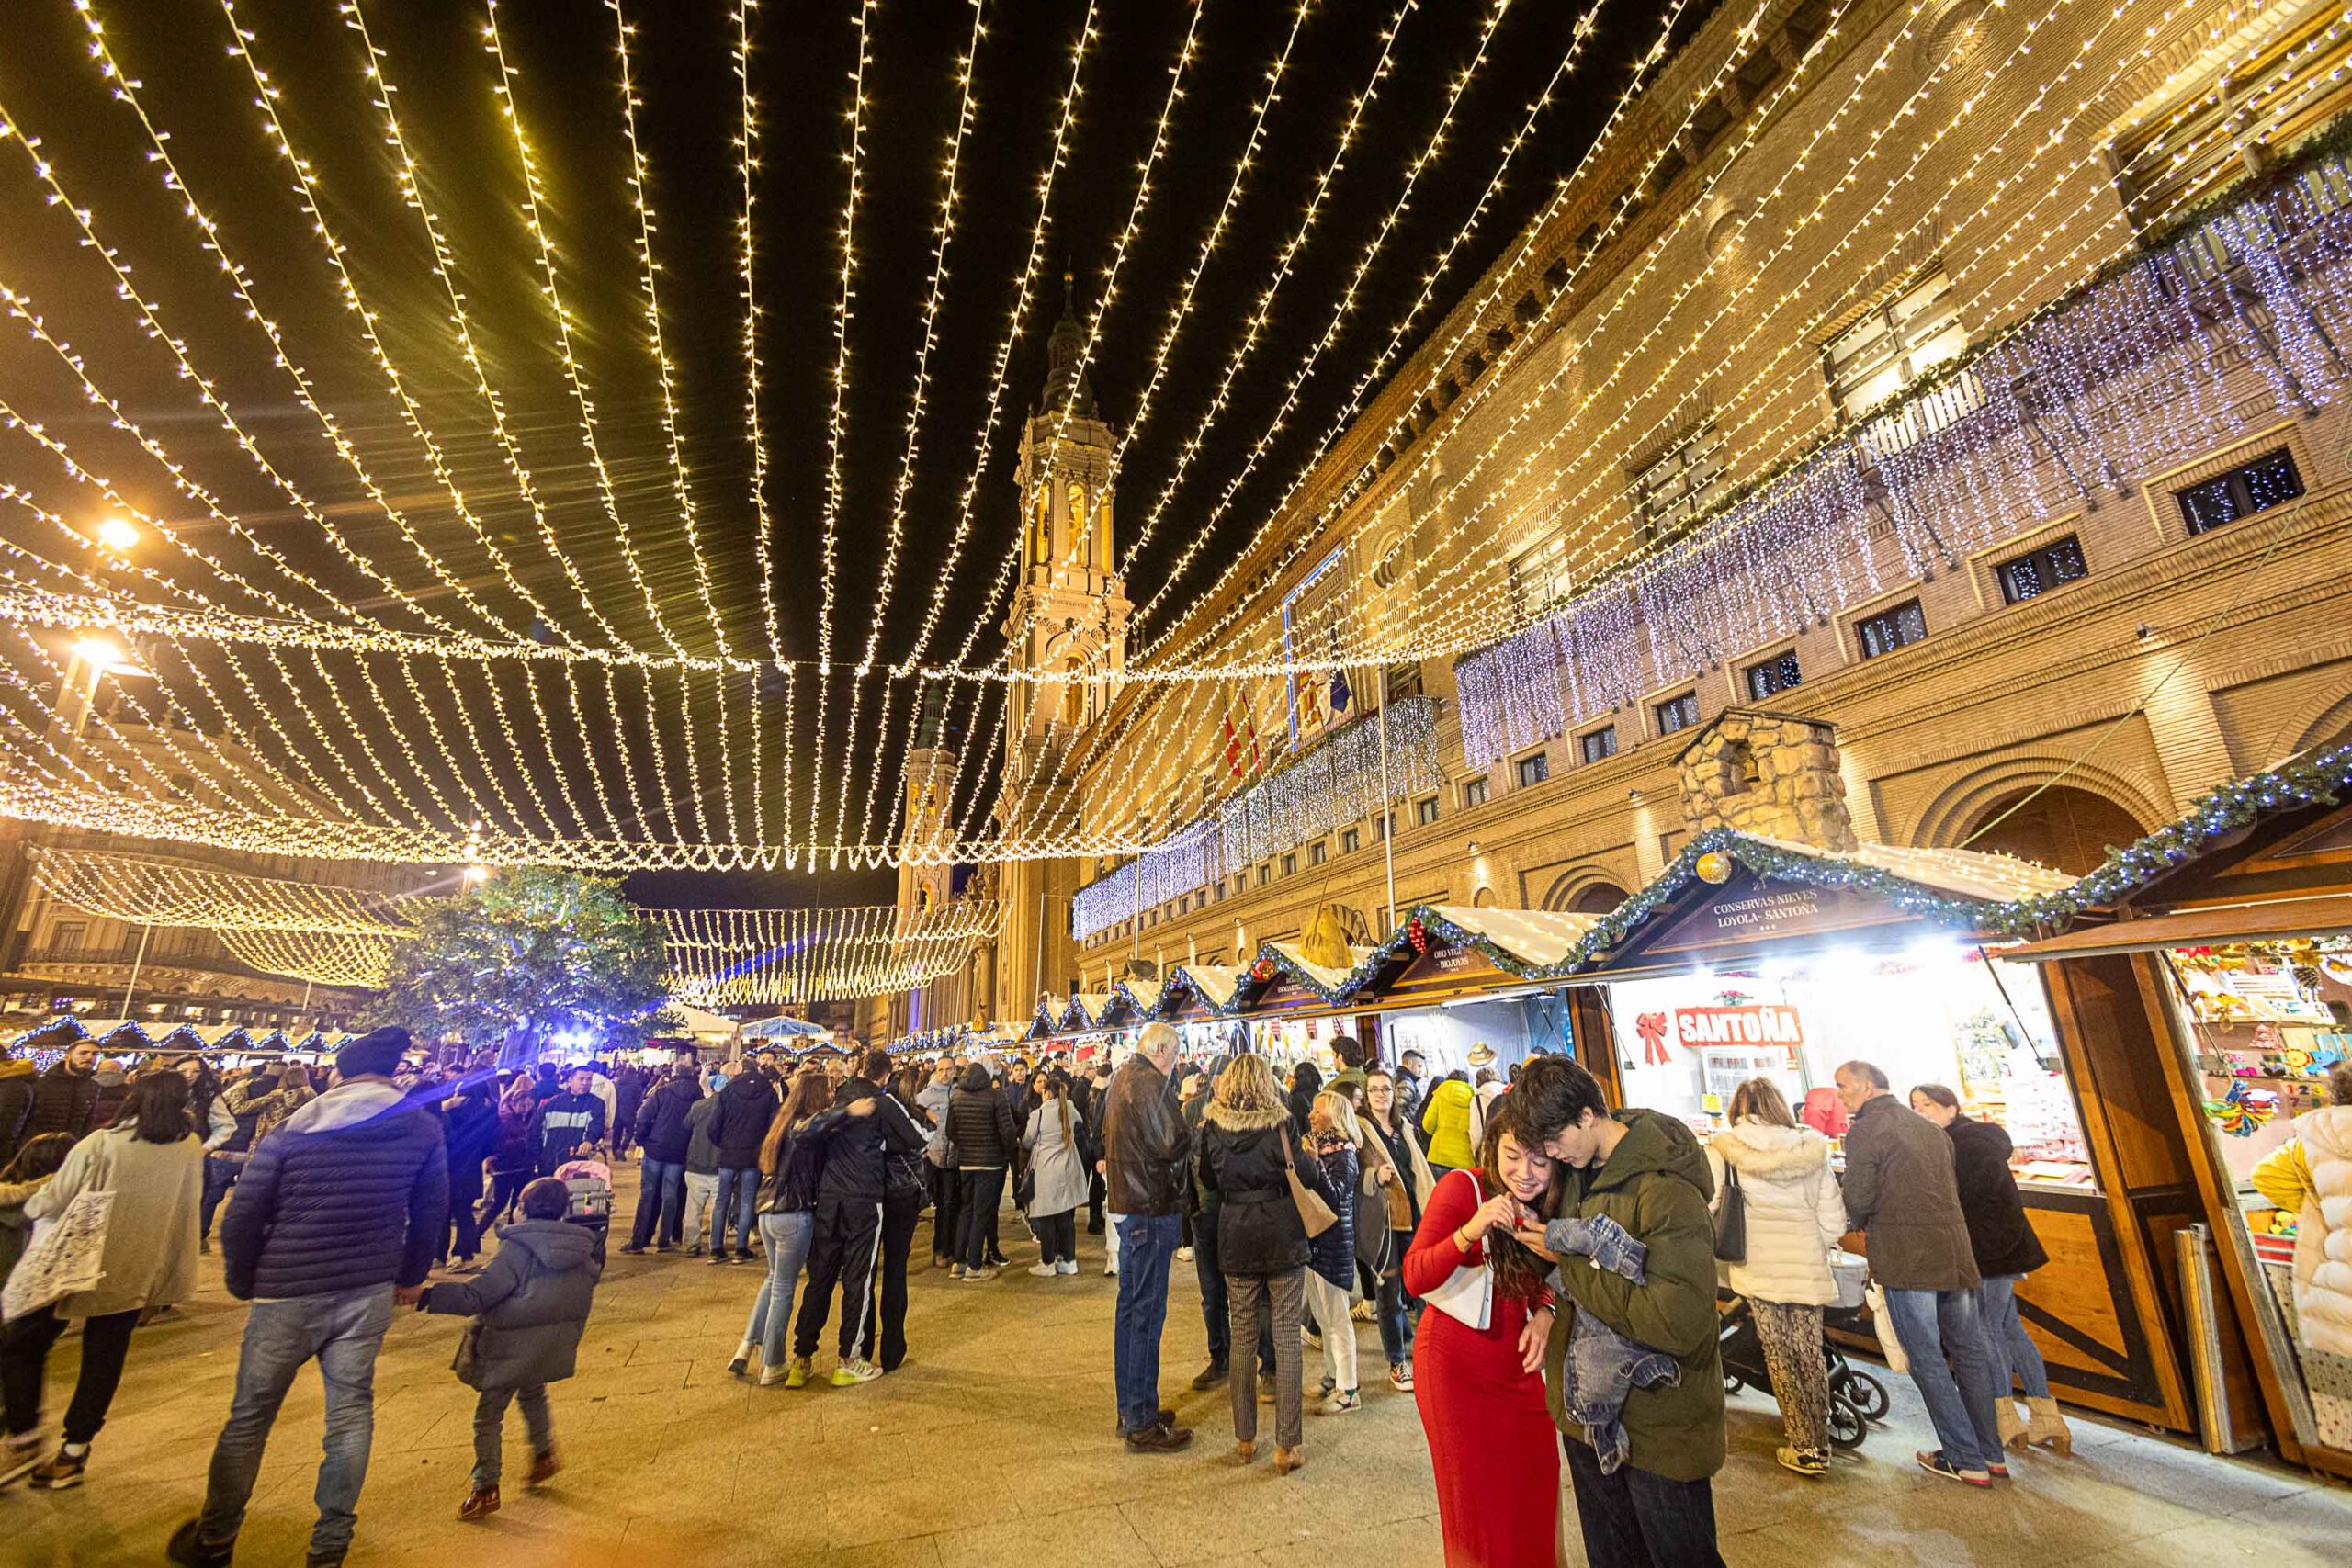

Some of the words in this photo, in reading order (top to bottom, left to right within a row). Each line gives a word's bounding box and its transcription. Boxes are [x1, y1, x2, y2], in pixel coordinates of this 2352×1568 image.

[1713, 896, 1774, 915] CONSERVAS
[1777, 888, 1817, 905] NIEVES
[1765, 902, 1818, 920] SANTOÑA
[1679, 1006, 1800, 1042] SANTOÑA
